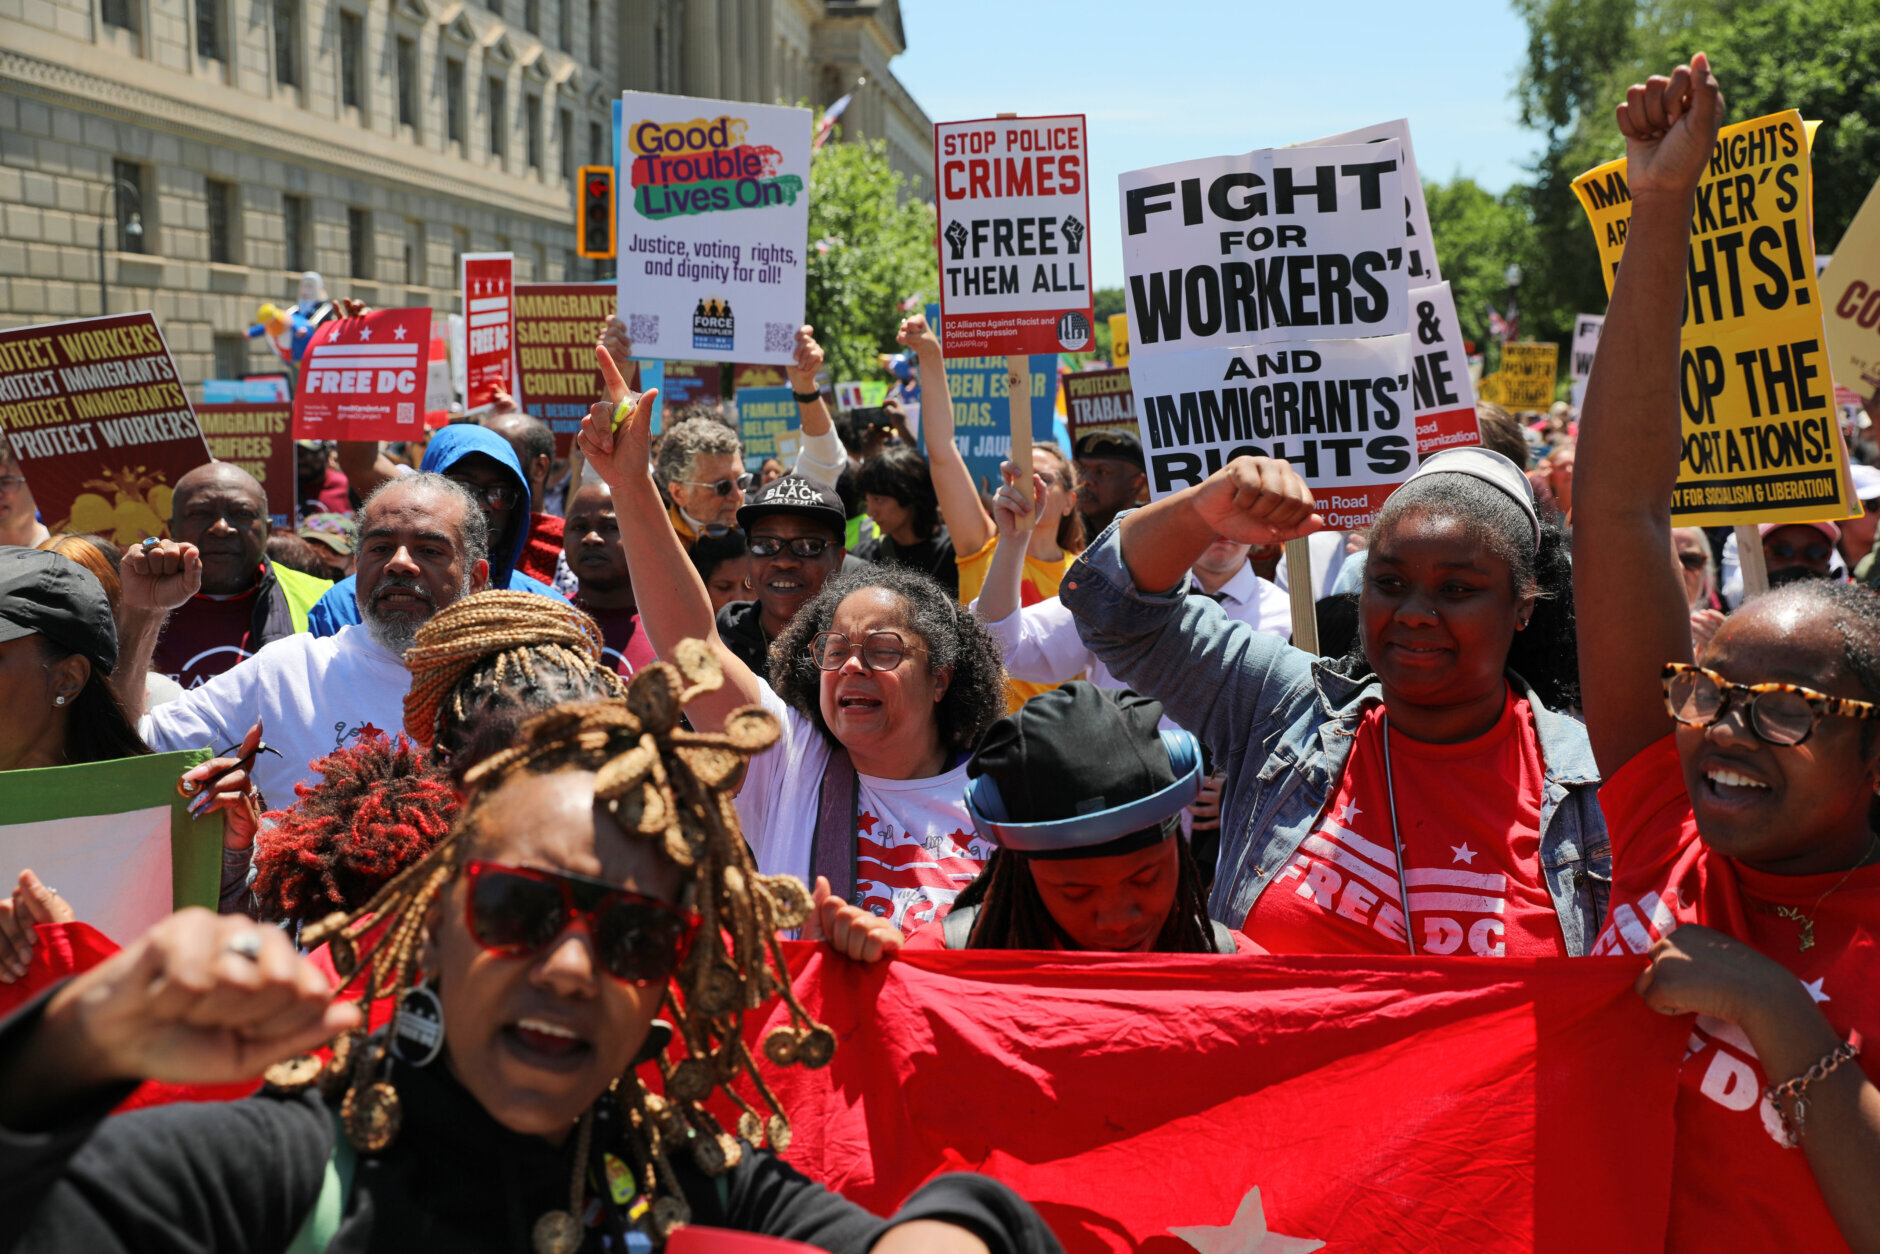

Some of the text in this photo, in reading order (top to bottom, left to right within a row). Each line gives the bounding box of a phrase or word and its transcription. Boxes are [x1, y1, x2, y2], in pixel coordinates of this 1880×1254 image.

[636, 118, 728, 154] Good
[944, 127, 1079, 155] STOP POLICE
[1710, 122, 1798, 177] RIGHTS
[638, 146, 762, 184] Trouble
[944, 155, 1081, 200] CRIMES
[642, 177, 782, 215] Lives On
[1126, 159, 1397, 236] FIGHT
[971, 216, 1058, 258] FREE
[1220, 224, 1307, 255] FOR
[1606, 218, 1631, 247] AR
[629, 234, 797, 267] Justice, voting rights,
[645, 258, 781, 284] and dignity for all!
[947, 262, 1085, 296] THEM ALL
[1129, 247, 1403, 345] WORKERS'
[695, 316, 732, 328] FORCE
[945, 317, 1055, 330] DC Alliance Against Racist and
[946, 328, 1018, 339] Political Repression
[1417, 301, 1444, 345] &
[0, 324, 162, 372] OTECT WORKERS
[470, 324, 509, 357] FREE DC
[520, 347, 565, 370] BUILT
[1223, 350, 1322, 381] AND
[0, 356, 174, 401] ROTECT IMMIGRANTS
[306, 370, 416, 394] FREE DC
[523, 373, 601, 397] COUNTRY.
[1735, 339, 1826, 417] THE
[0, 383, 186, 430] PROTECT IMMIGRANTS
[1143, 374, 1409, 449] IMMIGRANTS'
[7, 410, 199, 461] PROTECT WORKERS
[1416, 431, 1478, 453] rganization
[1151, 435, 1412, 493] RIHTS
[764, 486, 824, 503] BLACK
[780, 478, 808, 489] ALL
[1684, 487, 1704, 507] FOR
[1705, 484, 1755, 506] SOCIALISM
[1755, 483, 1765, 502] &
[1765, 477, 1833, 501] LIBERATION
[1331, 494, 1368, 509] Road
[1423, 917, 1506, 957] DC
